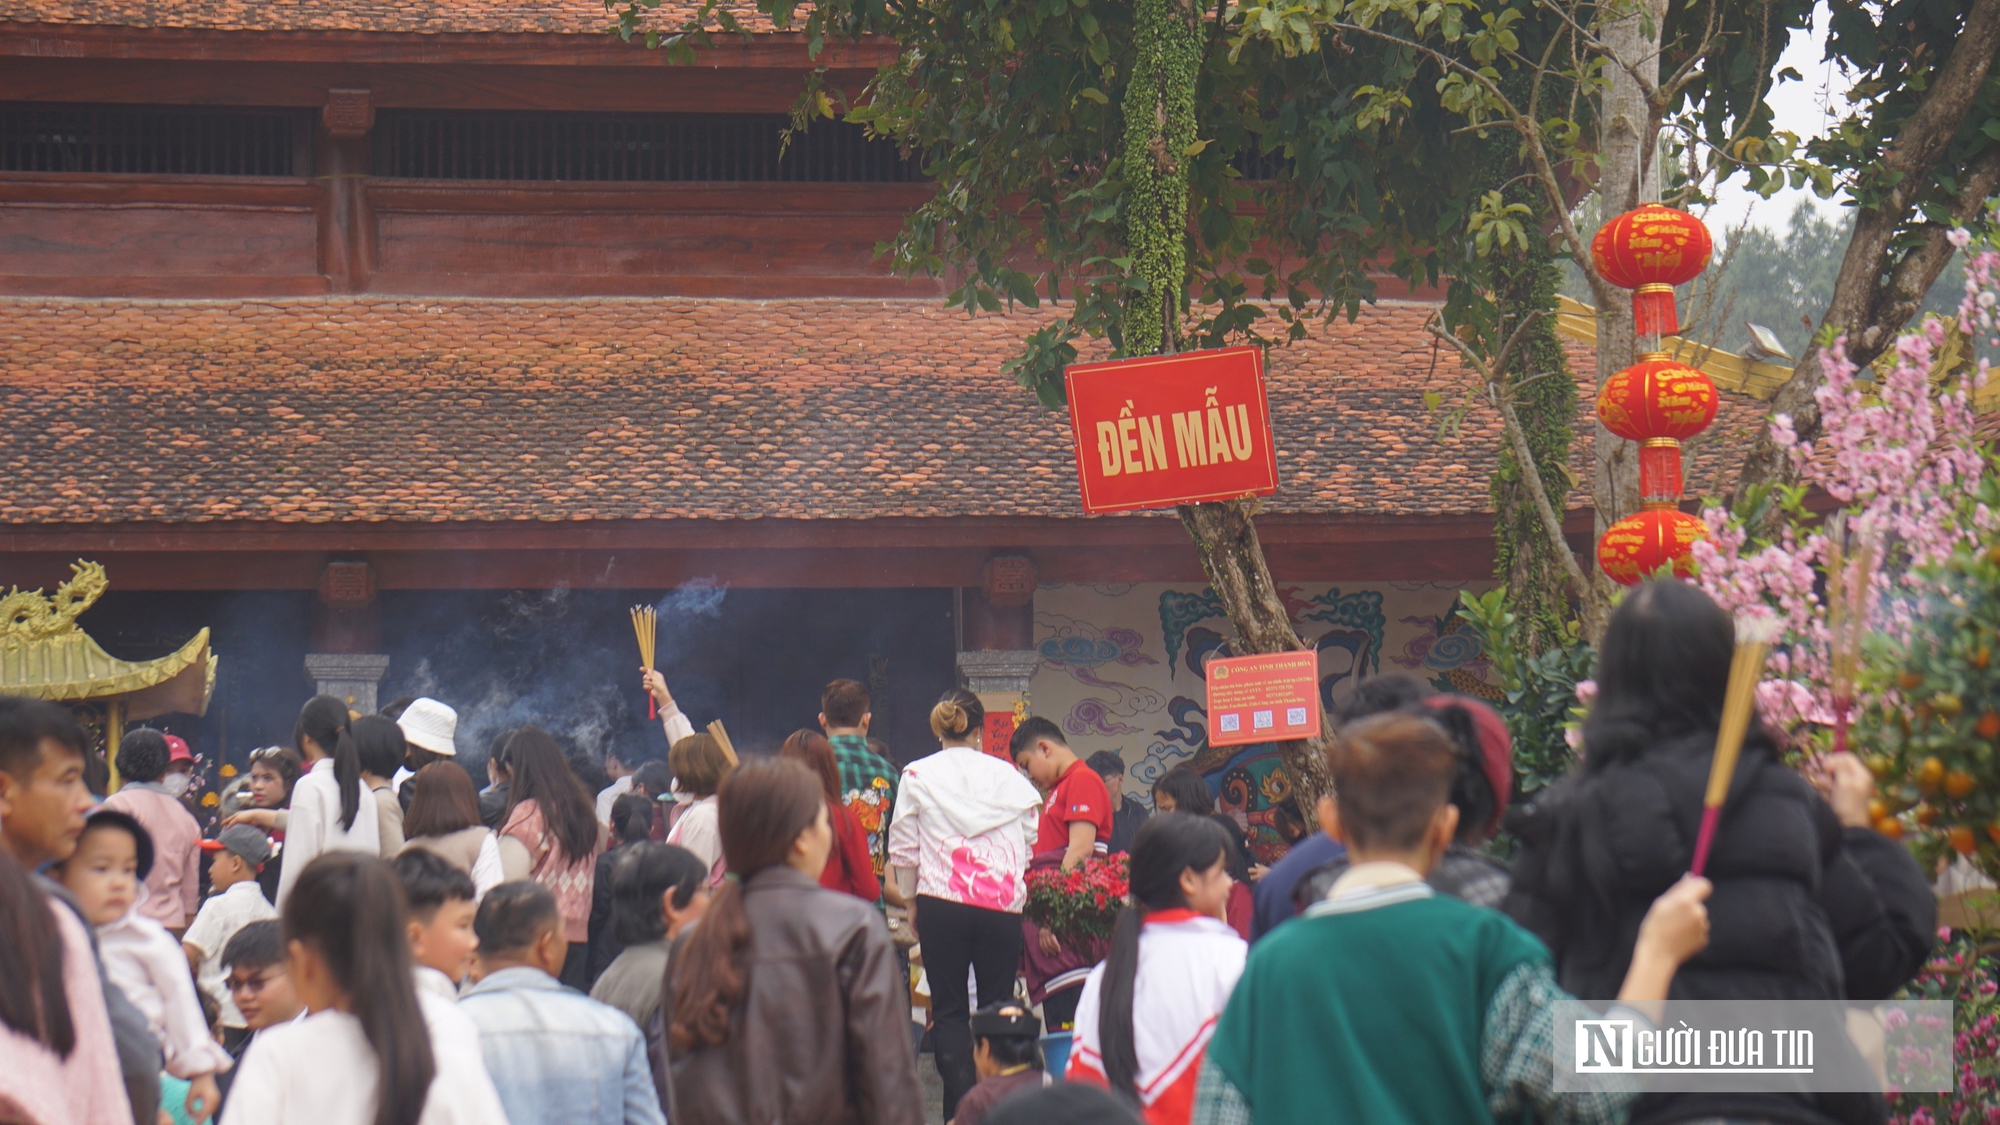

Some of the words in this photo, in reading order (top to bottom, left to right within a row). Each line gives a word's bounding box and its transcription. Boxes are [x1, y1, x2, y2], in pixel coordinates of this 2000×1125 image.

[1632, 210, 1682, 222] Chúc
[1628, 236, 1662, 249] Năm
[1642, 249, 1682, 267] Mới
[1654, 366, 1700, 380] Chúc
[1657, 395, 1692, 408] Năm
[1669, 405, 1708, 424] Mới
[1096, 399, 1168, 477] ĐỀN
[1172, 386, 1253, 468] MẪU
[1231, 665, 1248, 674] CÔNG
[1275, 661, 1296, 669] THANH
